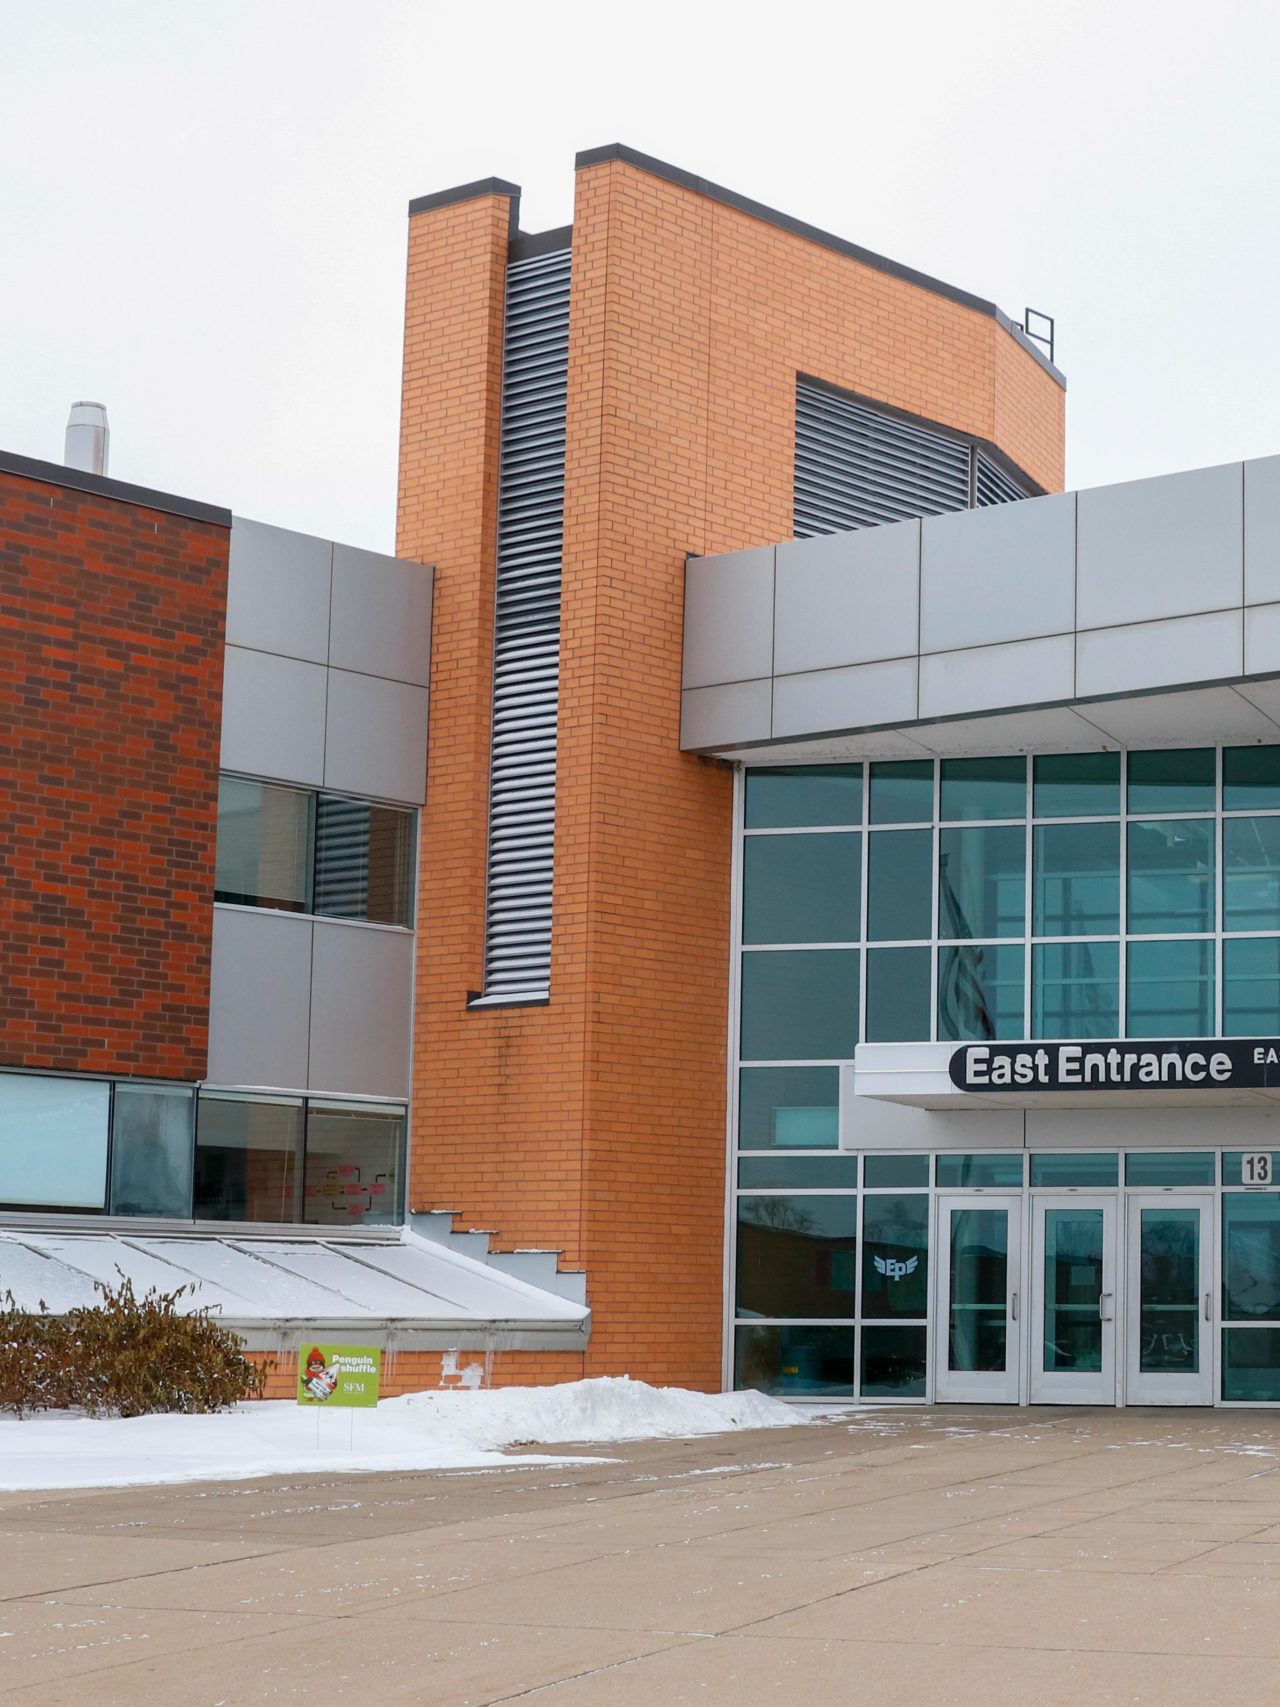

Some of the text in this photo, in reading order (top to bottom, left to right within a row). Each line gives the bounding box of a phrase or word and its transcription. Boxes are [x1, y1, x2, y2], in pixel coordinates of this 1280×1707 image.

[966, 1046, 1049, 1084] East
[1058, 1046, 1232, 1083] Entrance
[1246, 1156, 1268, 1181] 13
[332, 1354, 373, 1365] Penguin
[340, 1364, 377, 1373] shuffle
